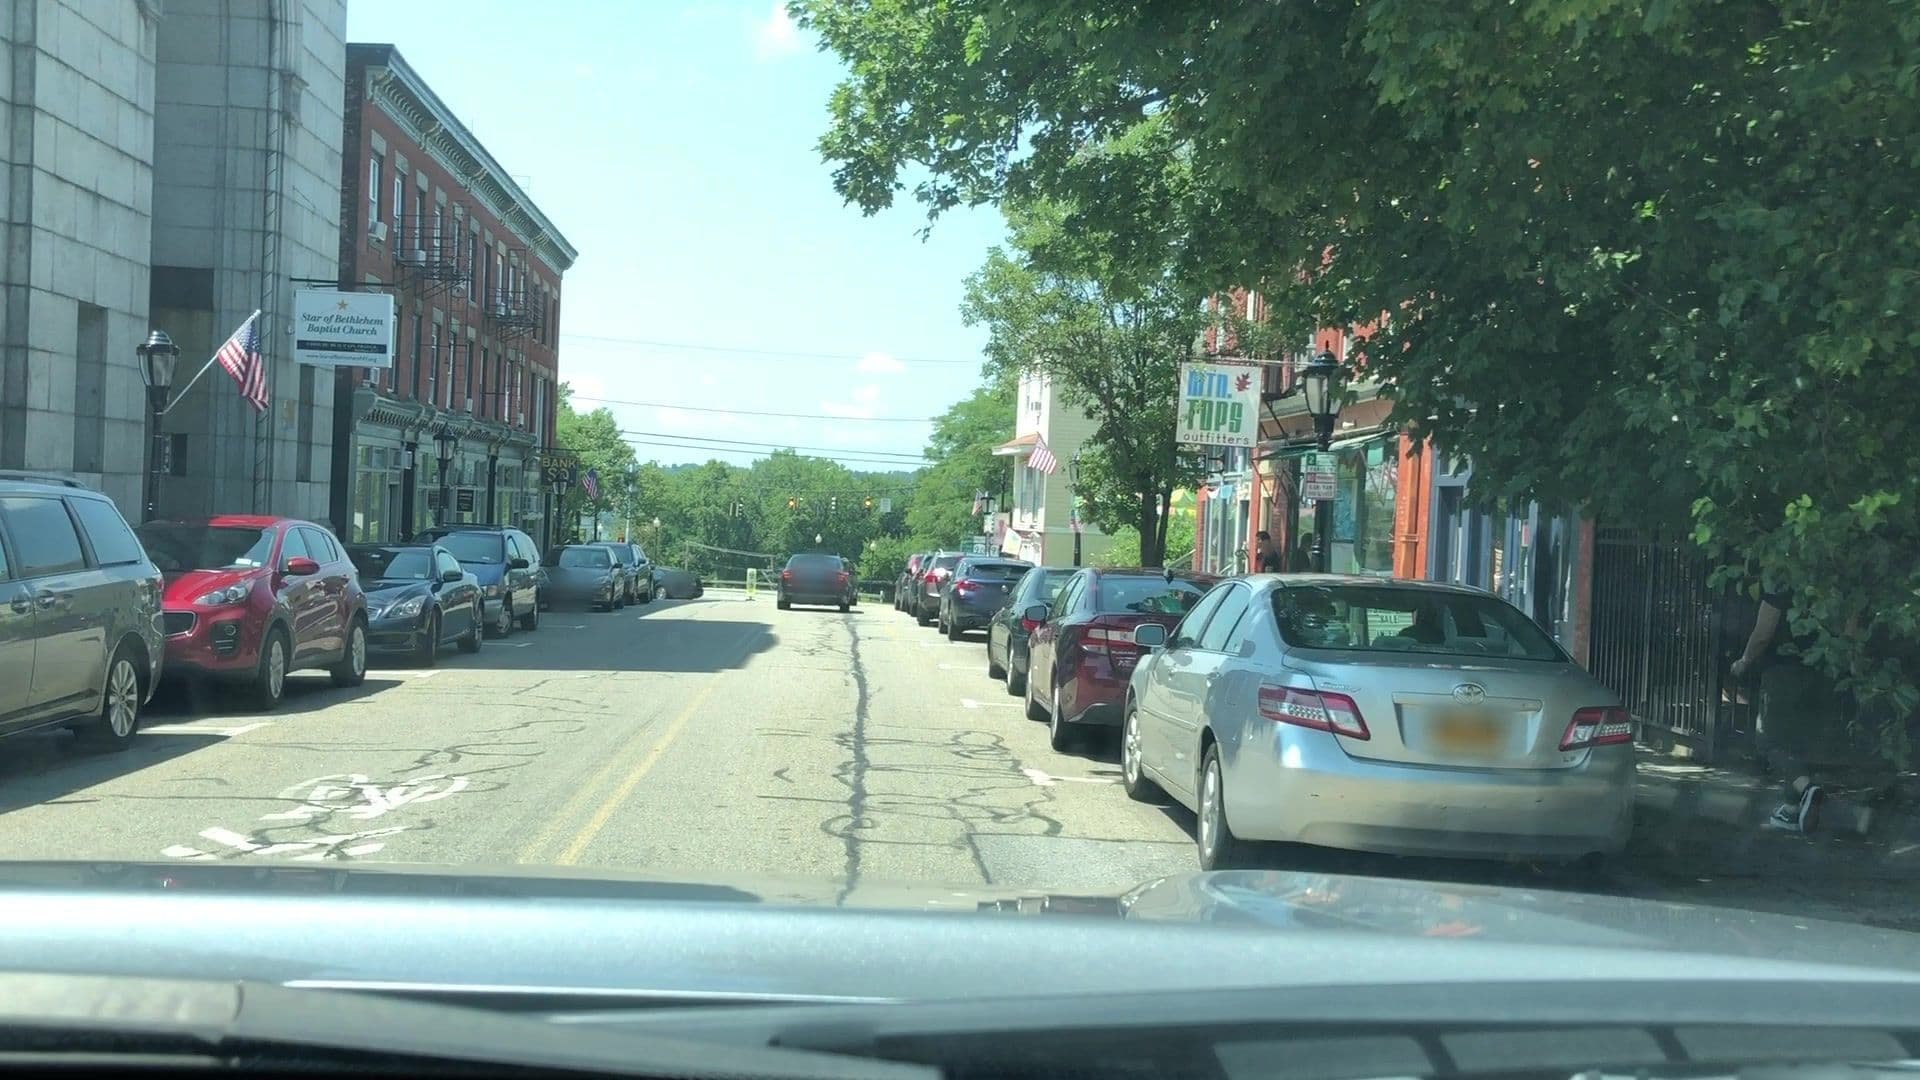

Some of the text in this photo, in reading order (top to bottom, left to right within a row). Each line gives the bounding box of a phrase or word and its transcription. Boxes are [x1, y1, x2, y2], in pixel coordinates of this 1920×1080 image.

[302, 312, 384, 326] Star of Bethlehem
[306, 323, 378, 336] Baptist Church
[1186, 399, 1244, 434] TOPS
[1183, 432, 1249, 445] outfitters
[542, 458, 576, 468] BANK
